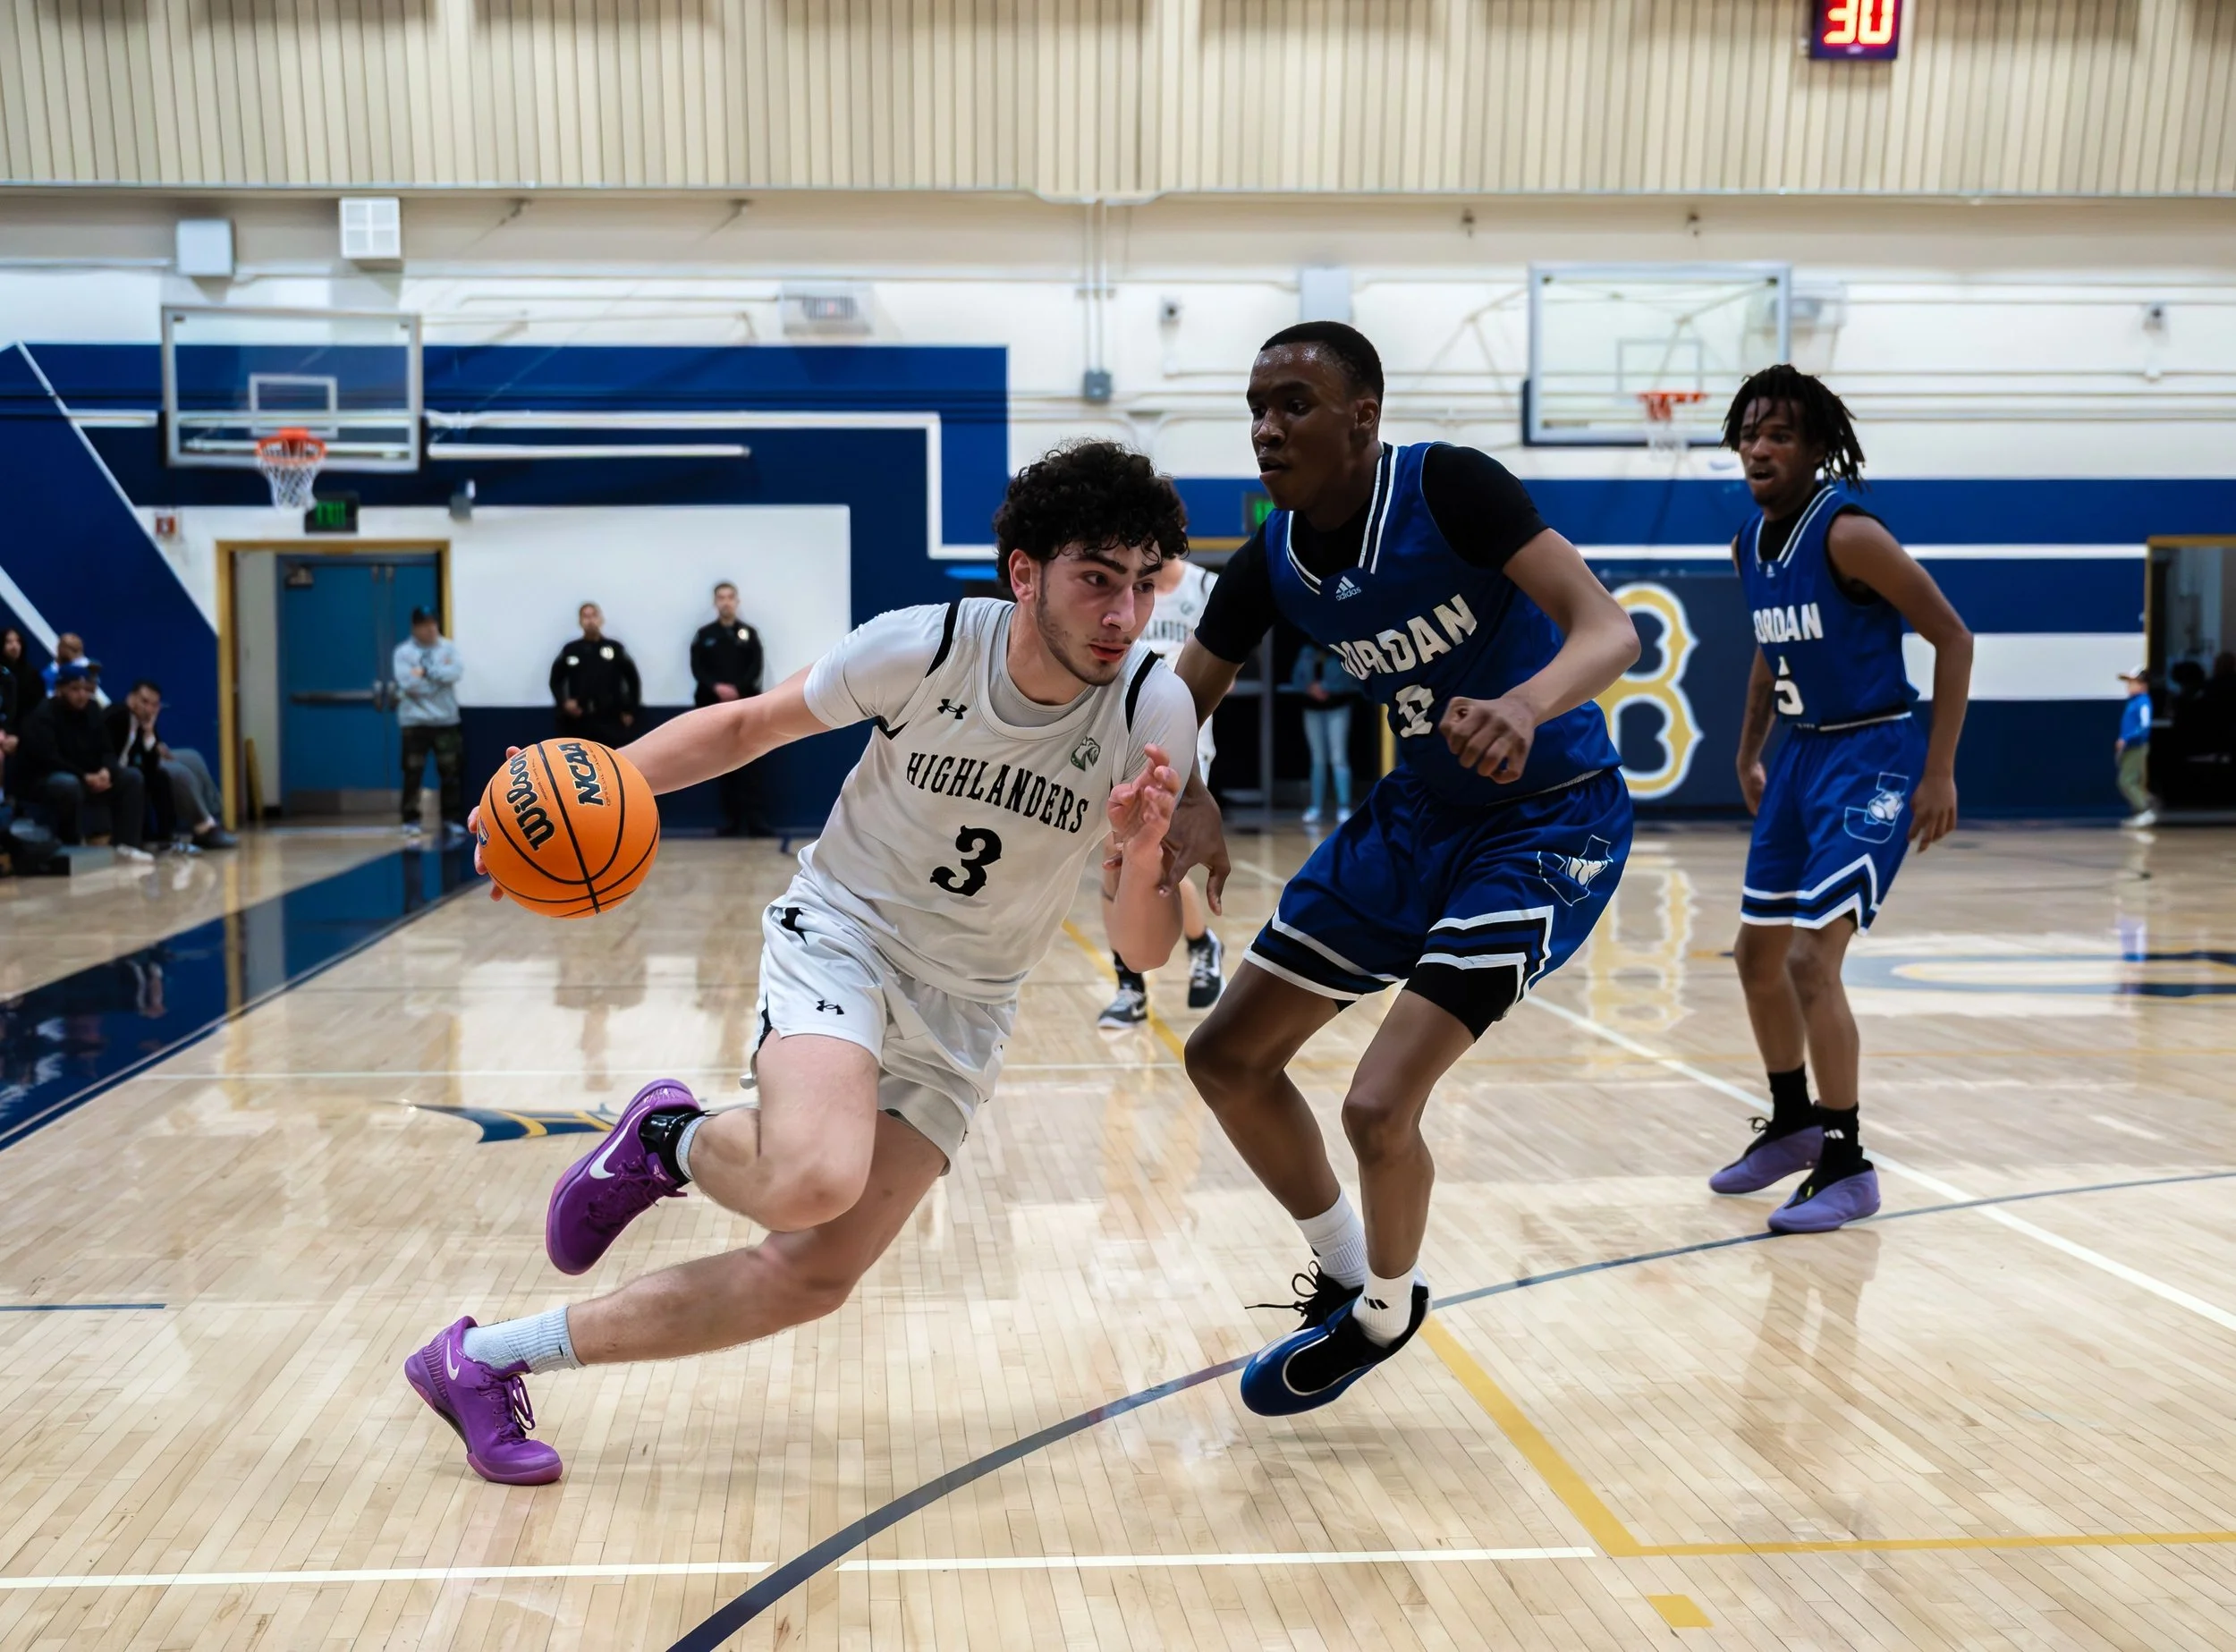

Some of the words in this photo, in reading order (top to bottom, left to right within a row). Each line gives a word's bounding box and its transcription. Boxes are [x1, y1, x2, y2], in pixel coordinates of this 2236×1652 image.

[1823, 0, 1894, 45] 30
[1335, 587, 1361, 601] adidas
[1753, 602, 1825, 644] ORDAN
[506, 750, 555, 851] Wilson
[556, 741, 606, 807] NCAA
[906, 752, 1089, 834] HIGHLANDERS
[929, 825, 1002, 896] 3
